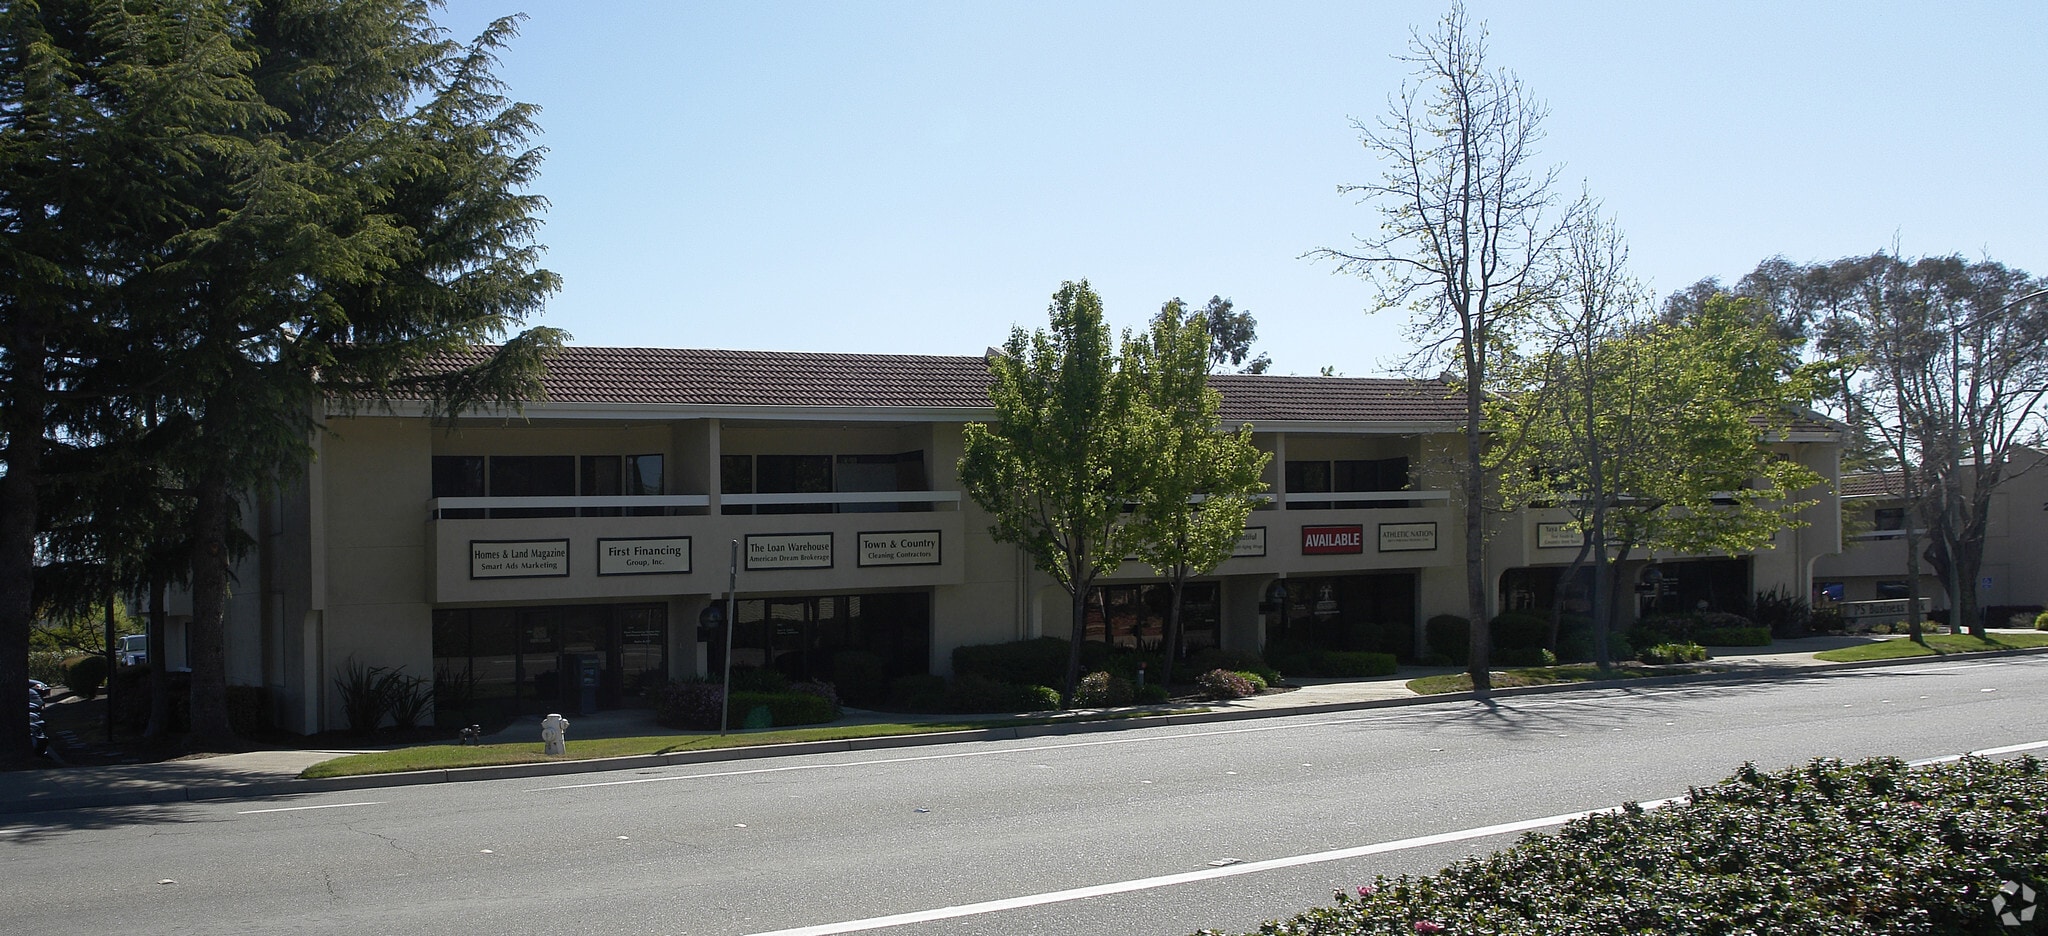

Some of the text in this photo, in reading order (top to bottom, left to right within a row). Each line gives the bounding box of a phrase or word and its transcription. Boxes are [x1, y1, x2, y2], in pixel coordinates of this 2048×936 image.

[864, 539, 936, 549] Town & Country
[1305, 532, 1360, 547] AVAILABLE
[608, 545, 681, 557] First Financing
[750, 542, 829, 552] The Loan Warehouse
[474, 548, 565, 560] Homes & Land Magazine
[521, 561, 557, 569] Marketing
[626, 559, 650, 567] Group,
[1855, 605, 1865, 615] PS
[1869, 603, 1905, 615] Business
